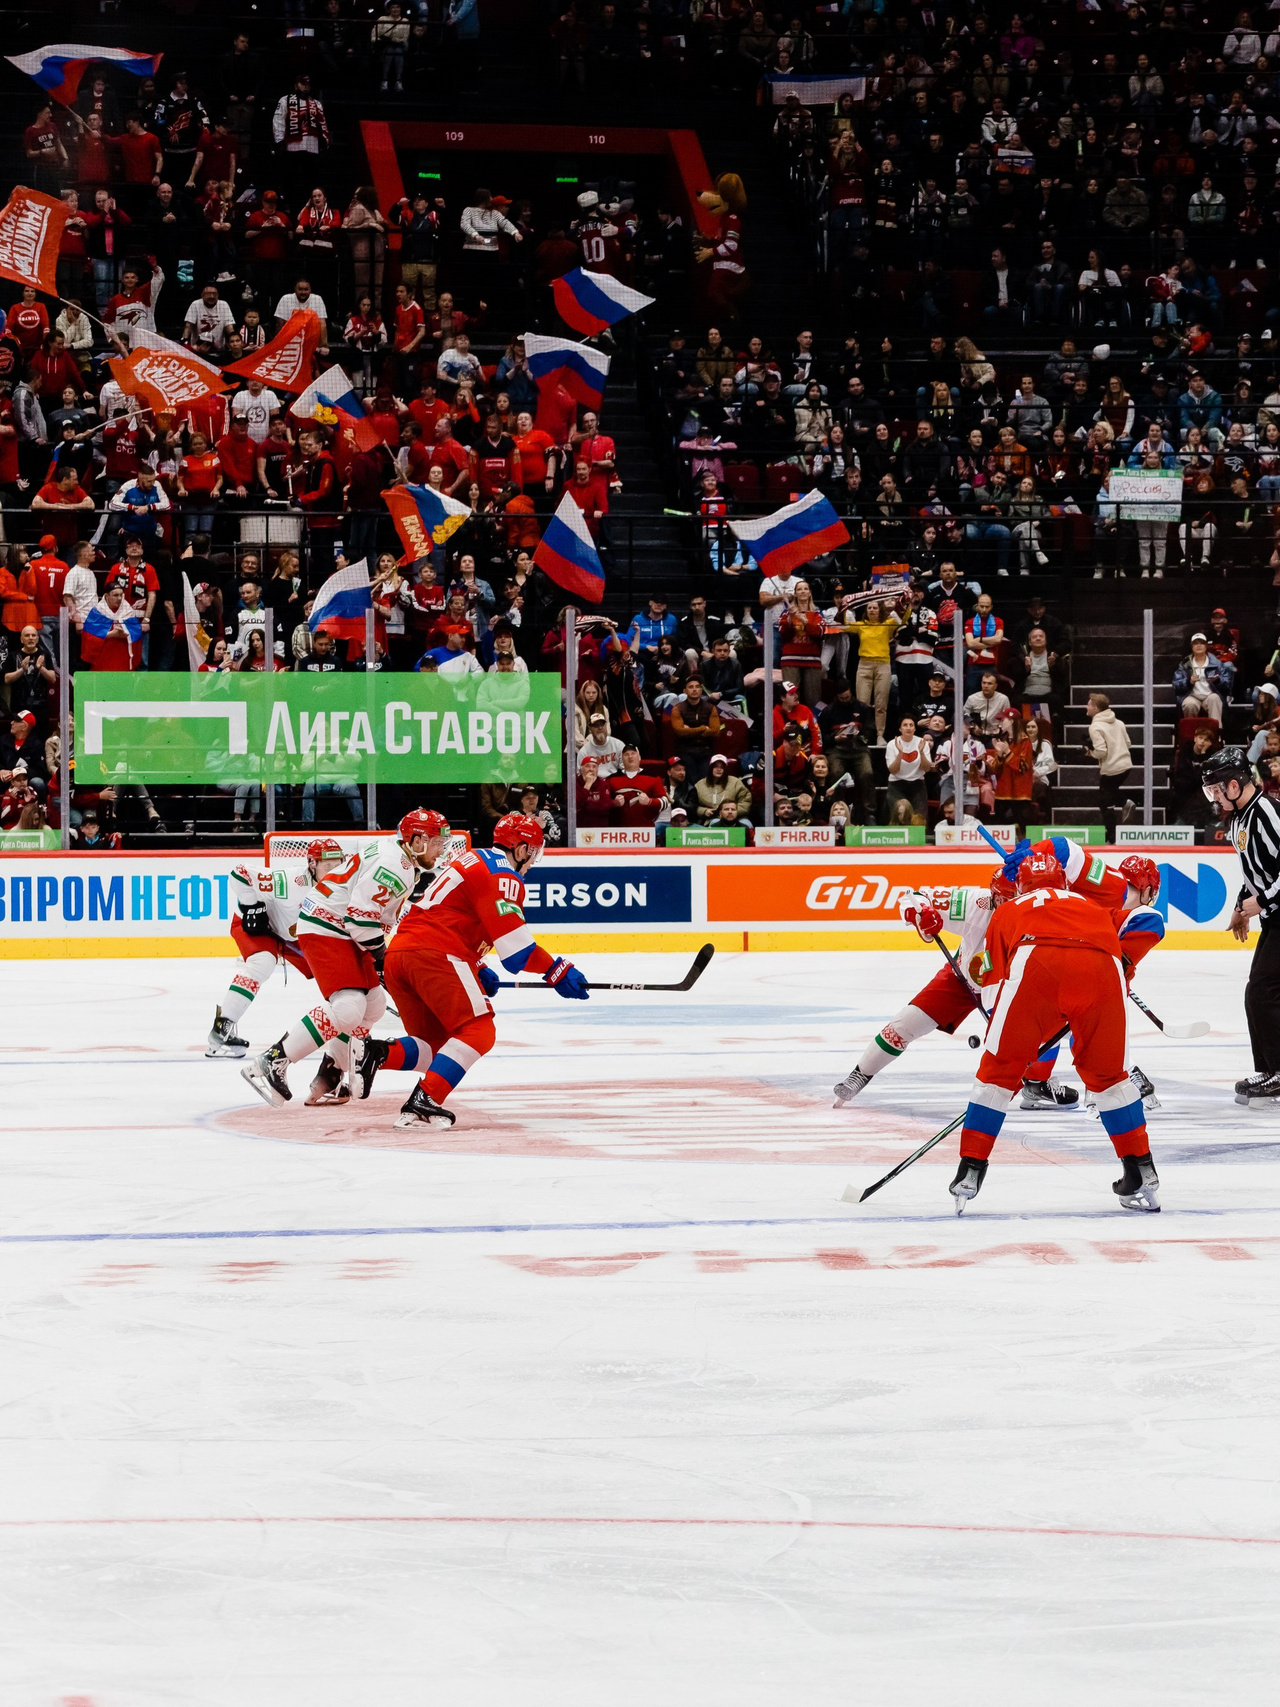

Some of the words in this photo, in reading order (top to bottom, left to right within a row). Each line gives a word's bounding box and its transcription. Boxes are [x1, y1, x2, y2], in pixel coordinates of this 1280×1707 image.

[445, 131, 464, 142] 109
[589, 134, 606, 145] 110
[48, 573, 55, 588] 1
[600, 832, 651, 843] FHR.RU
[780, 831, 830, 843] FHR.RU
[960, 830, 1010, 842] FHRU
[1120, 830, 1190, 841] ПОЛИПЛАСТ
[1032, 861, 1046, 871] 25
[498, 877, 520, 902] 90
[524, 883, 647, 907] ERSON
[0, 874, 229, 922] ПРОМНЕФТ
